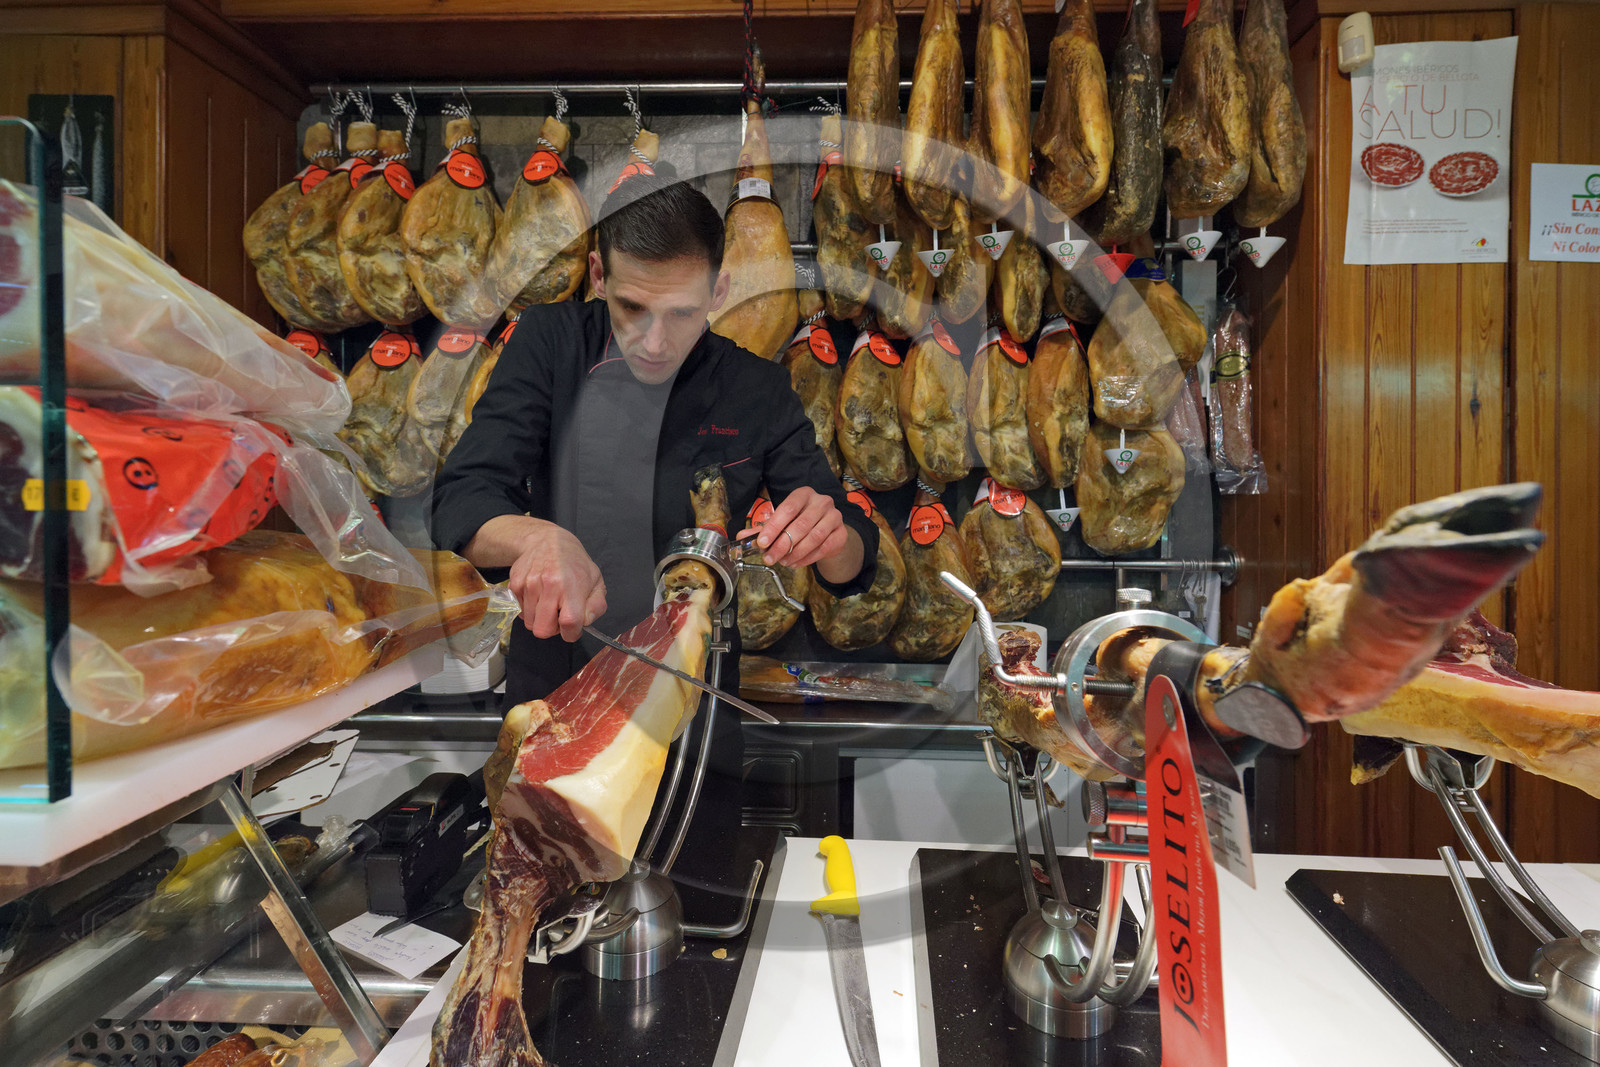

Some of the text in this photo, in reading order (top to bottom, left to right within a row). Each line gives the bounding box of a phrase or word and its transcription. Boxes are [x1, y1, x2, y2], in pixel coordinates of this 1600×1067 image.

[1359, 84, 1447, 116] A TU
[1358, 108, 1502, 141] SALUD!
[1552, 241, 1567, 252] Ni
[1161, 757, 1202, 1038] JOSELITO
